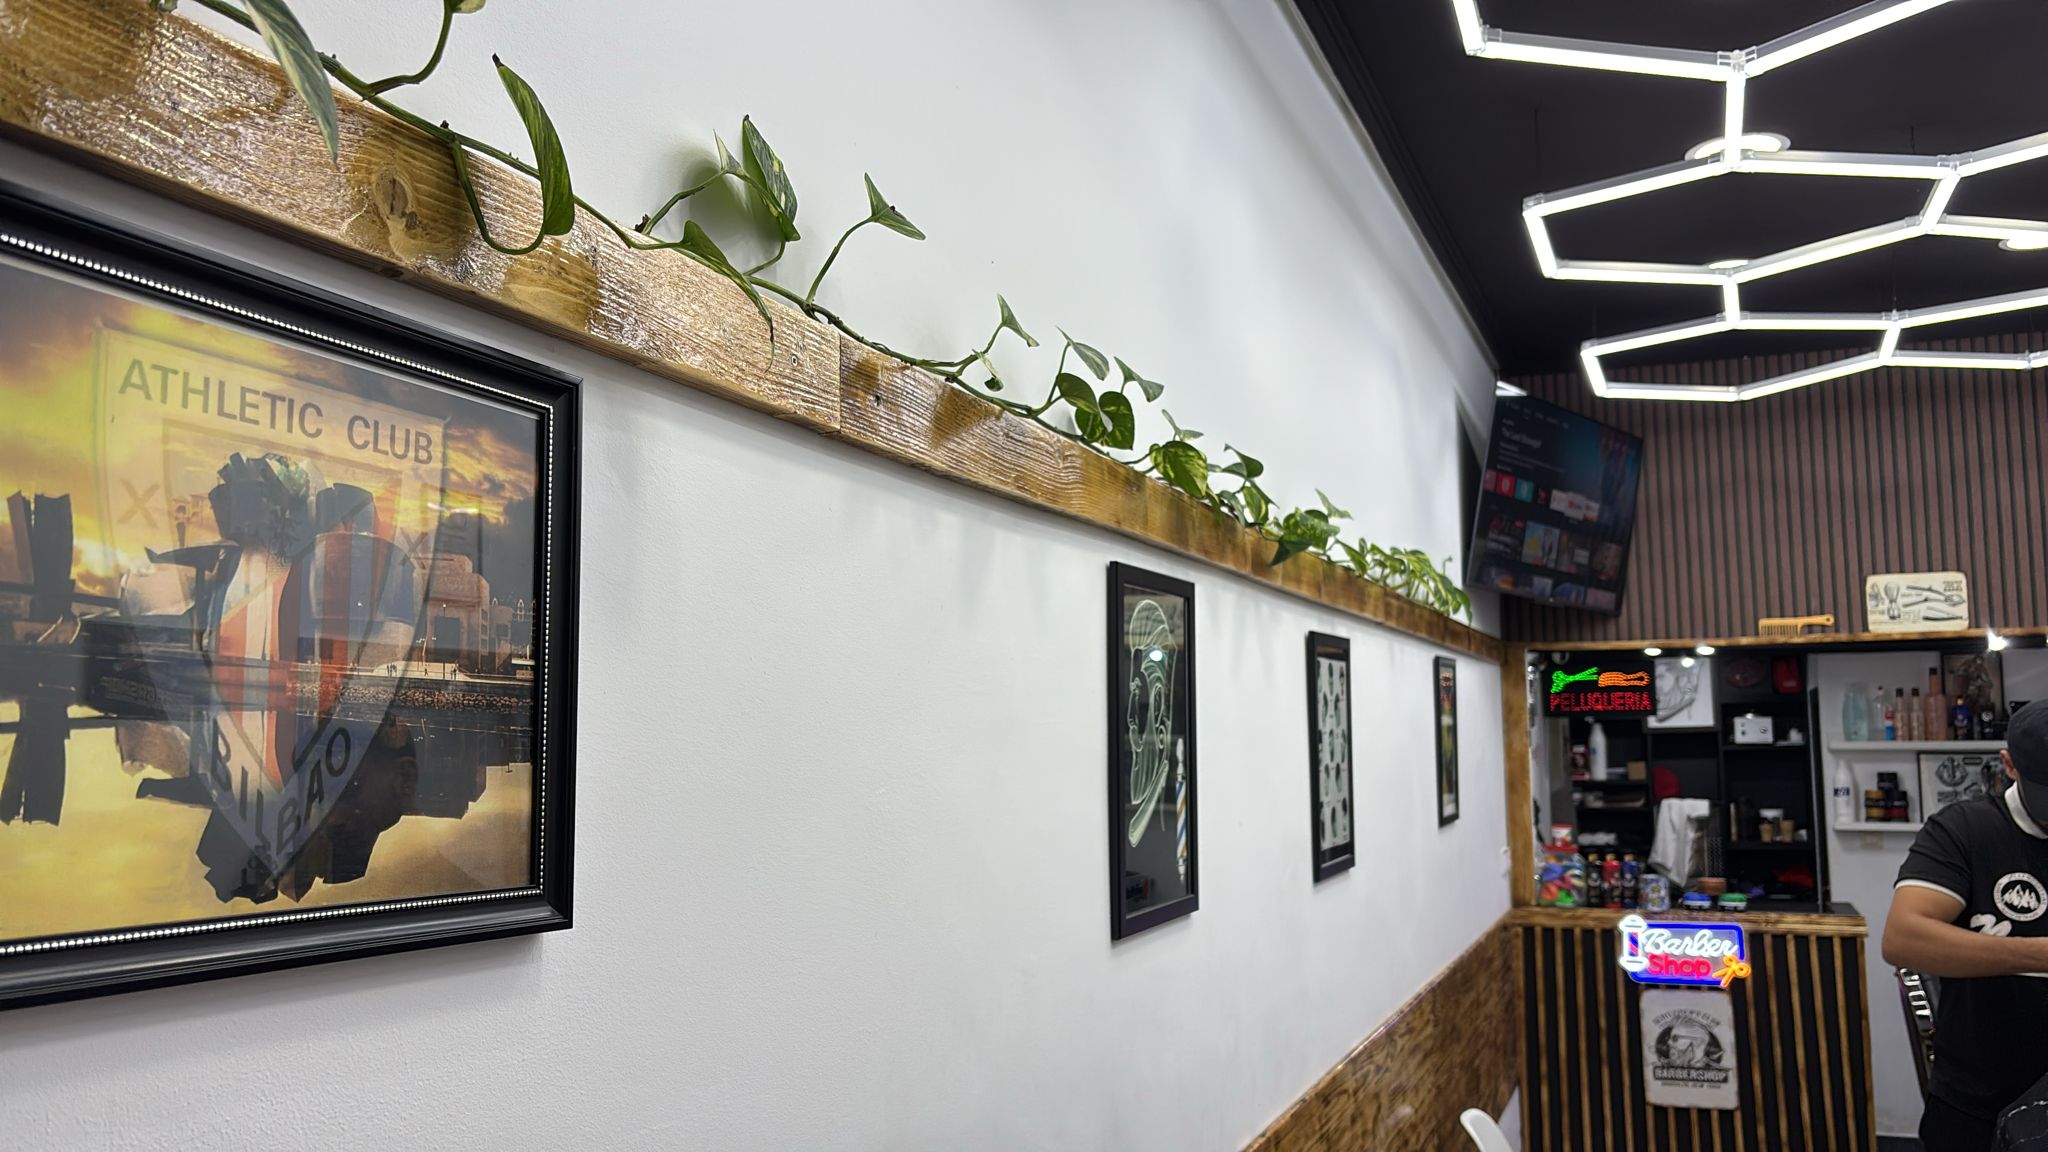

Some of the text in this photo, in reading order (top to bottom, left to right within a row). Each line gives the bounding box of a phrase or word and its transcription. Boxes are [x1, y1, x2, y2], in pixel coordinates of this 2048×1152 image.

[118, 358, 434, 464] ATHLETIC CLUB
[1550, 692, 1652, 711] PELUQUERIA
[1644, 929, 1739, 956] Barber
[1648, 954, 1711, 978] Shop
[1655, 1067, 1728, 1083] BARBERSHOP
